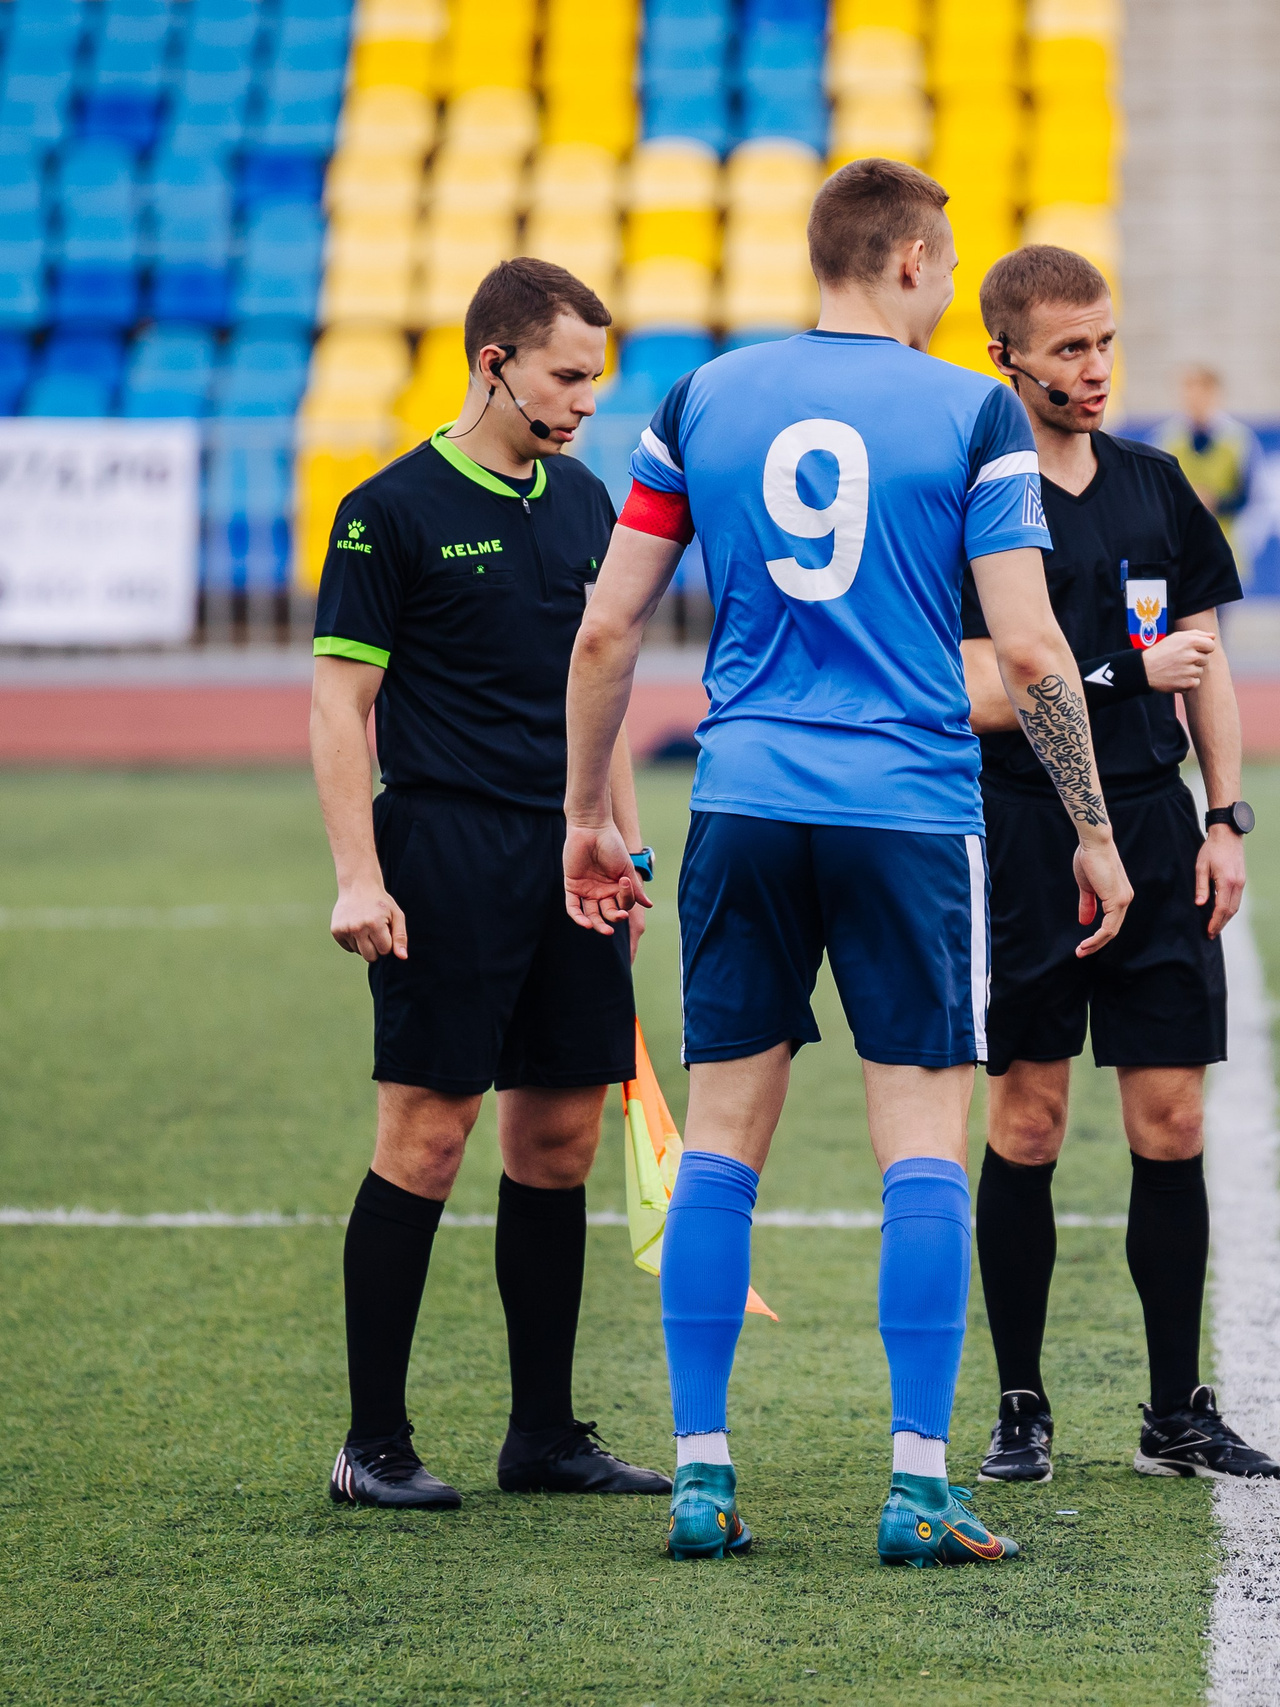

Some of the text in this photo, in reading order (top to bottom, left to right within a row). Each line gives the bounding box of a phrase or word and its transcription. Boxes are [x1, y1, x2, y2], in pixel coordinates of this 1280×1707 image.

[763, 418, 869, 602] 9
[337, 540, 372, 554] KELME
[441, 539, 503, 559] KELME
